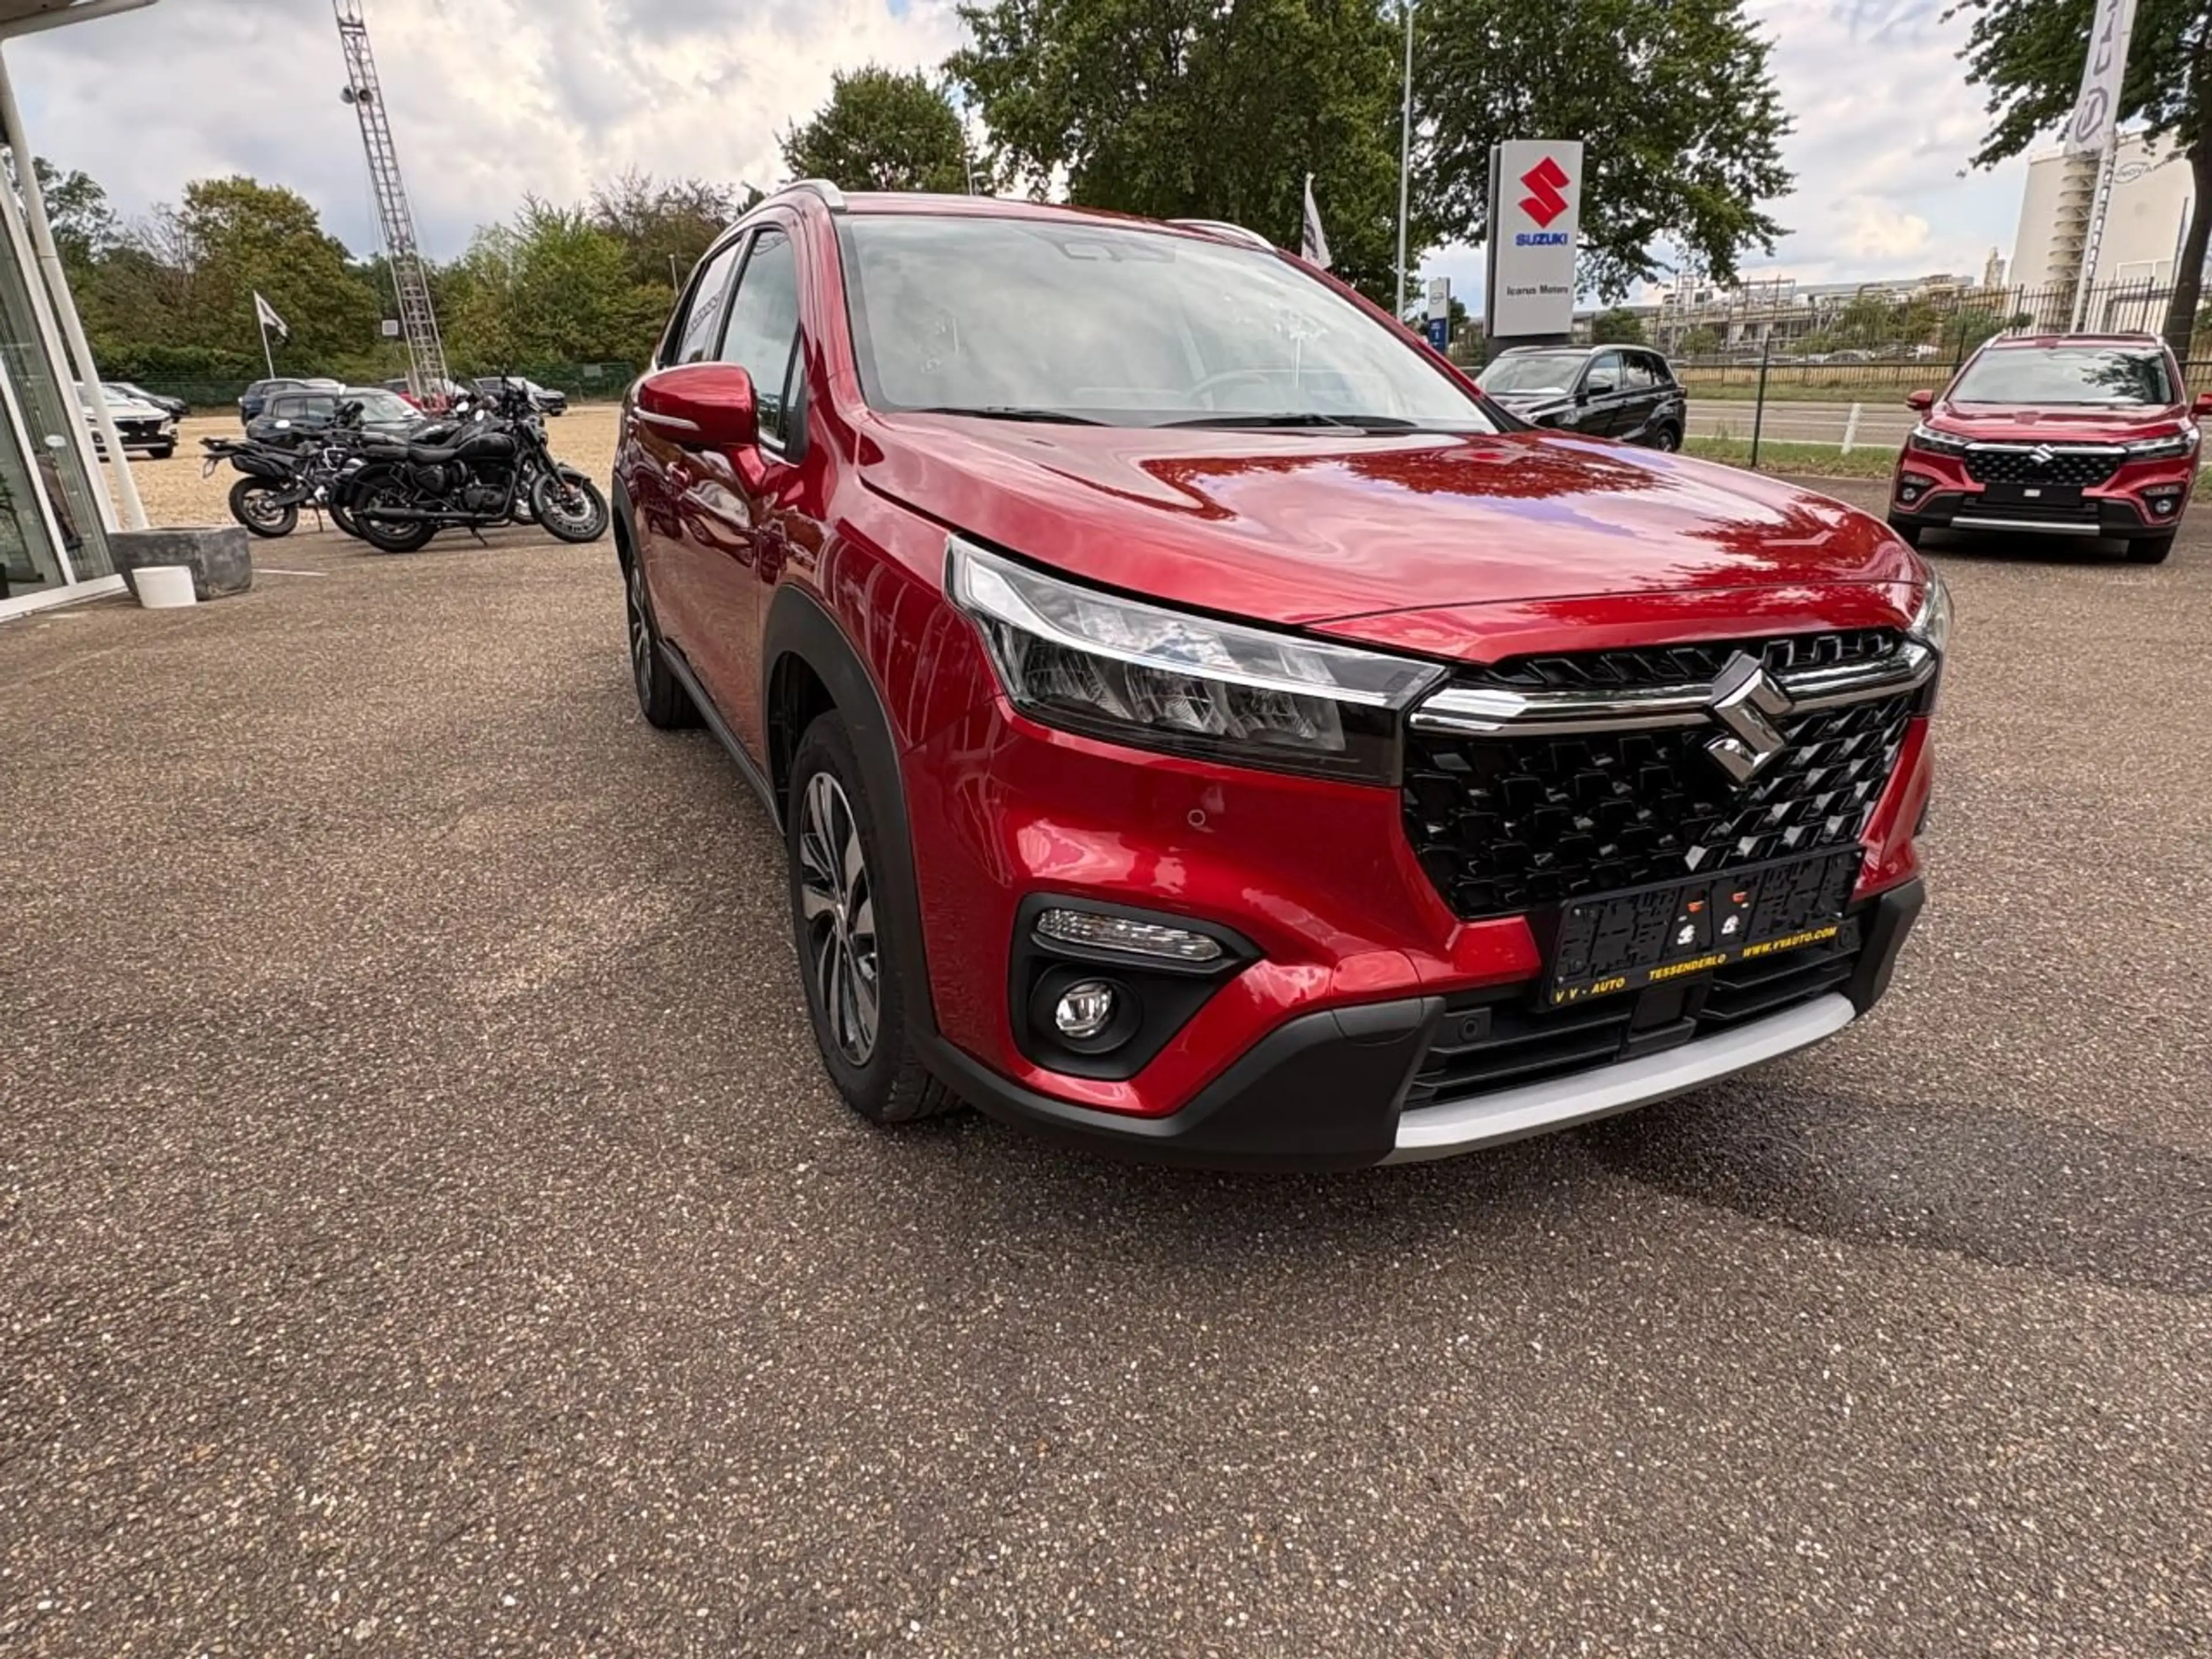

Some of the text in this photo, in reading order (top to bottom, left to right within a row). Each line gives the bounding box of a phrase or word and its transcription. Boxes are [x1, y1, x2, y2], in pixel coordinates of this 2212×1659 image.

[1516, 233, 1569, 247] SUZUKI
[1507, 284, 1569, 296] Icarus Motors
[1591, 976, 1626, 995] AUTO
[1649, 953, 1726, 981] TESSENDERLO
